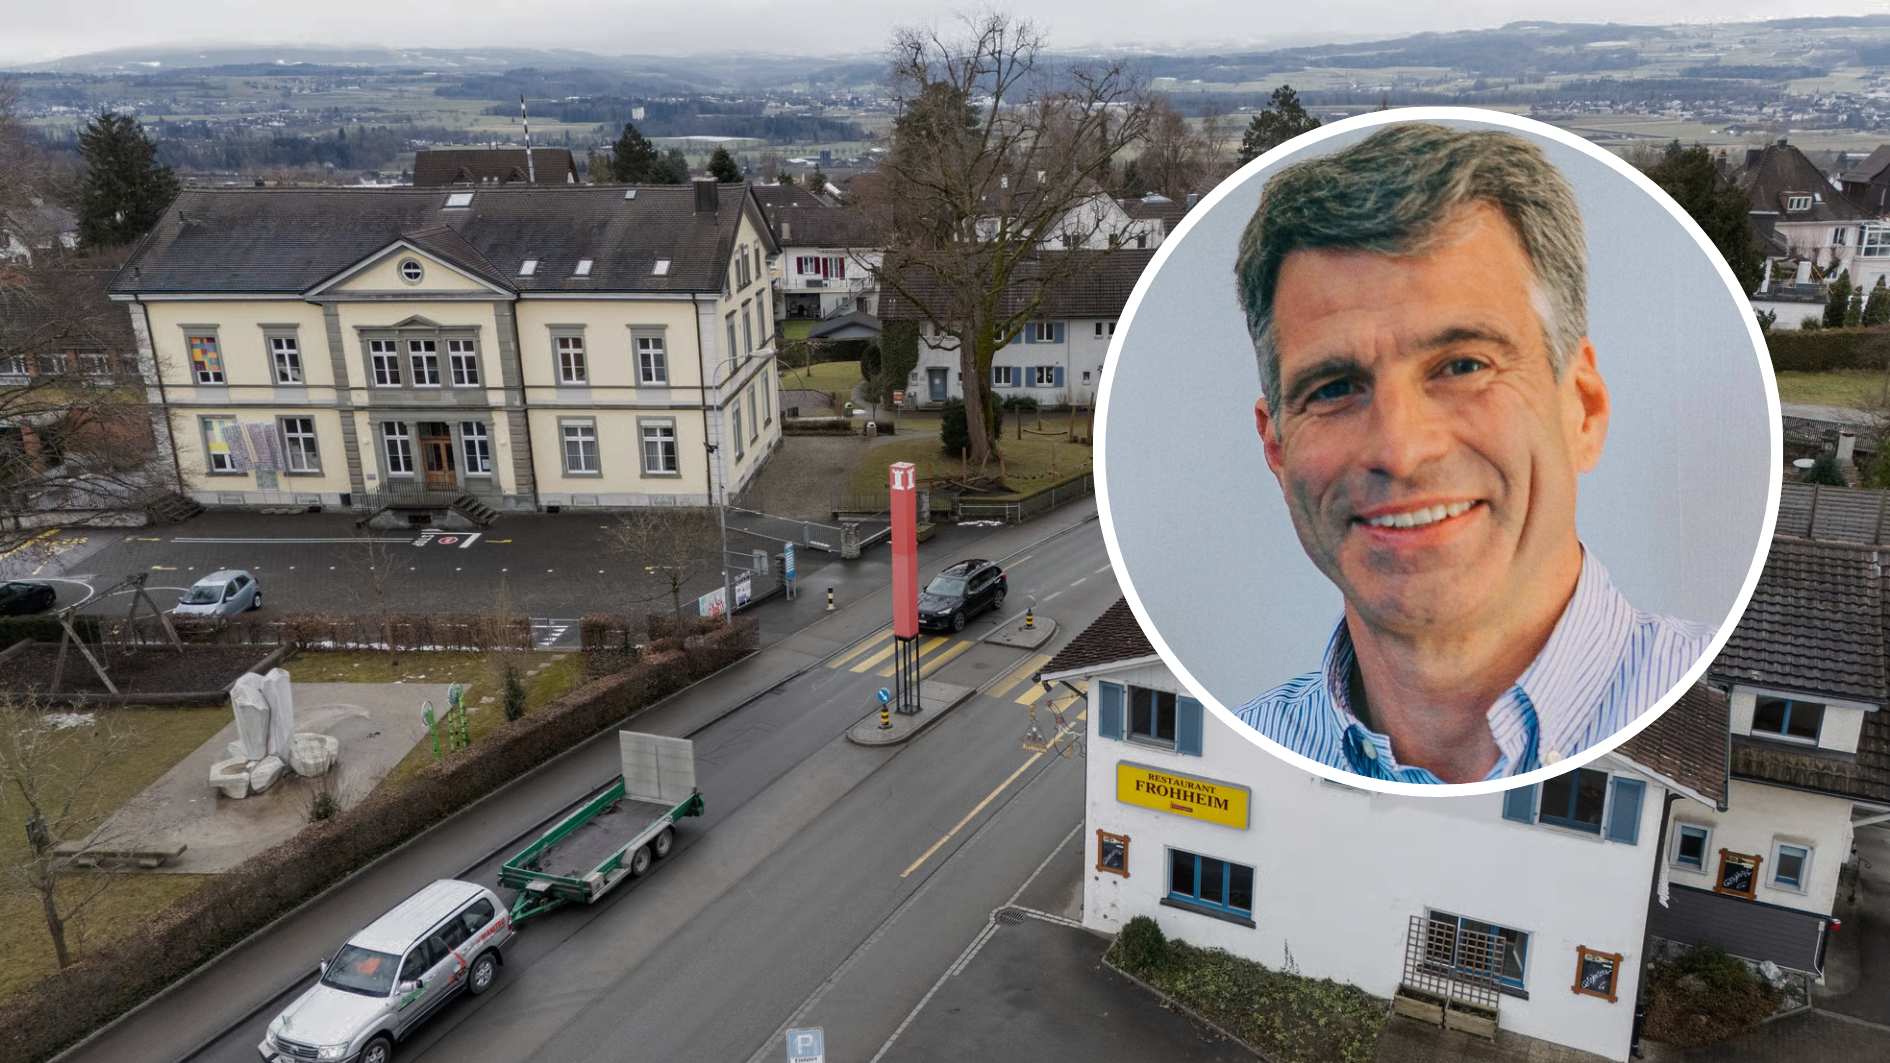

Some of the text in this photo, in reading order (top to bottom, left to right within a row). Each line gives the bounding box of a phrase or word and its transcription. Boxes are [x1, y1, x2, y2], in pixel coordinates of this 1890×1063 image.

[1148, 773, 1216, 794] RESTAURANT
[1135, 779, 1229, 811] FROHHEIM
[481, 917, 505, 940] MANITOU
[797, 1034, 813, 1055] P
